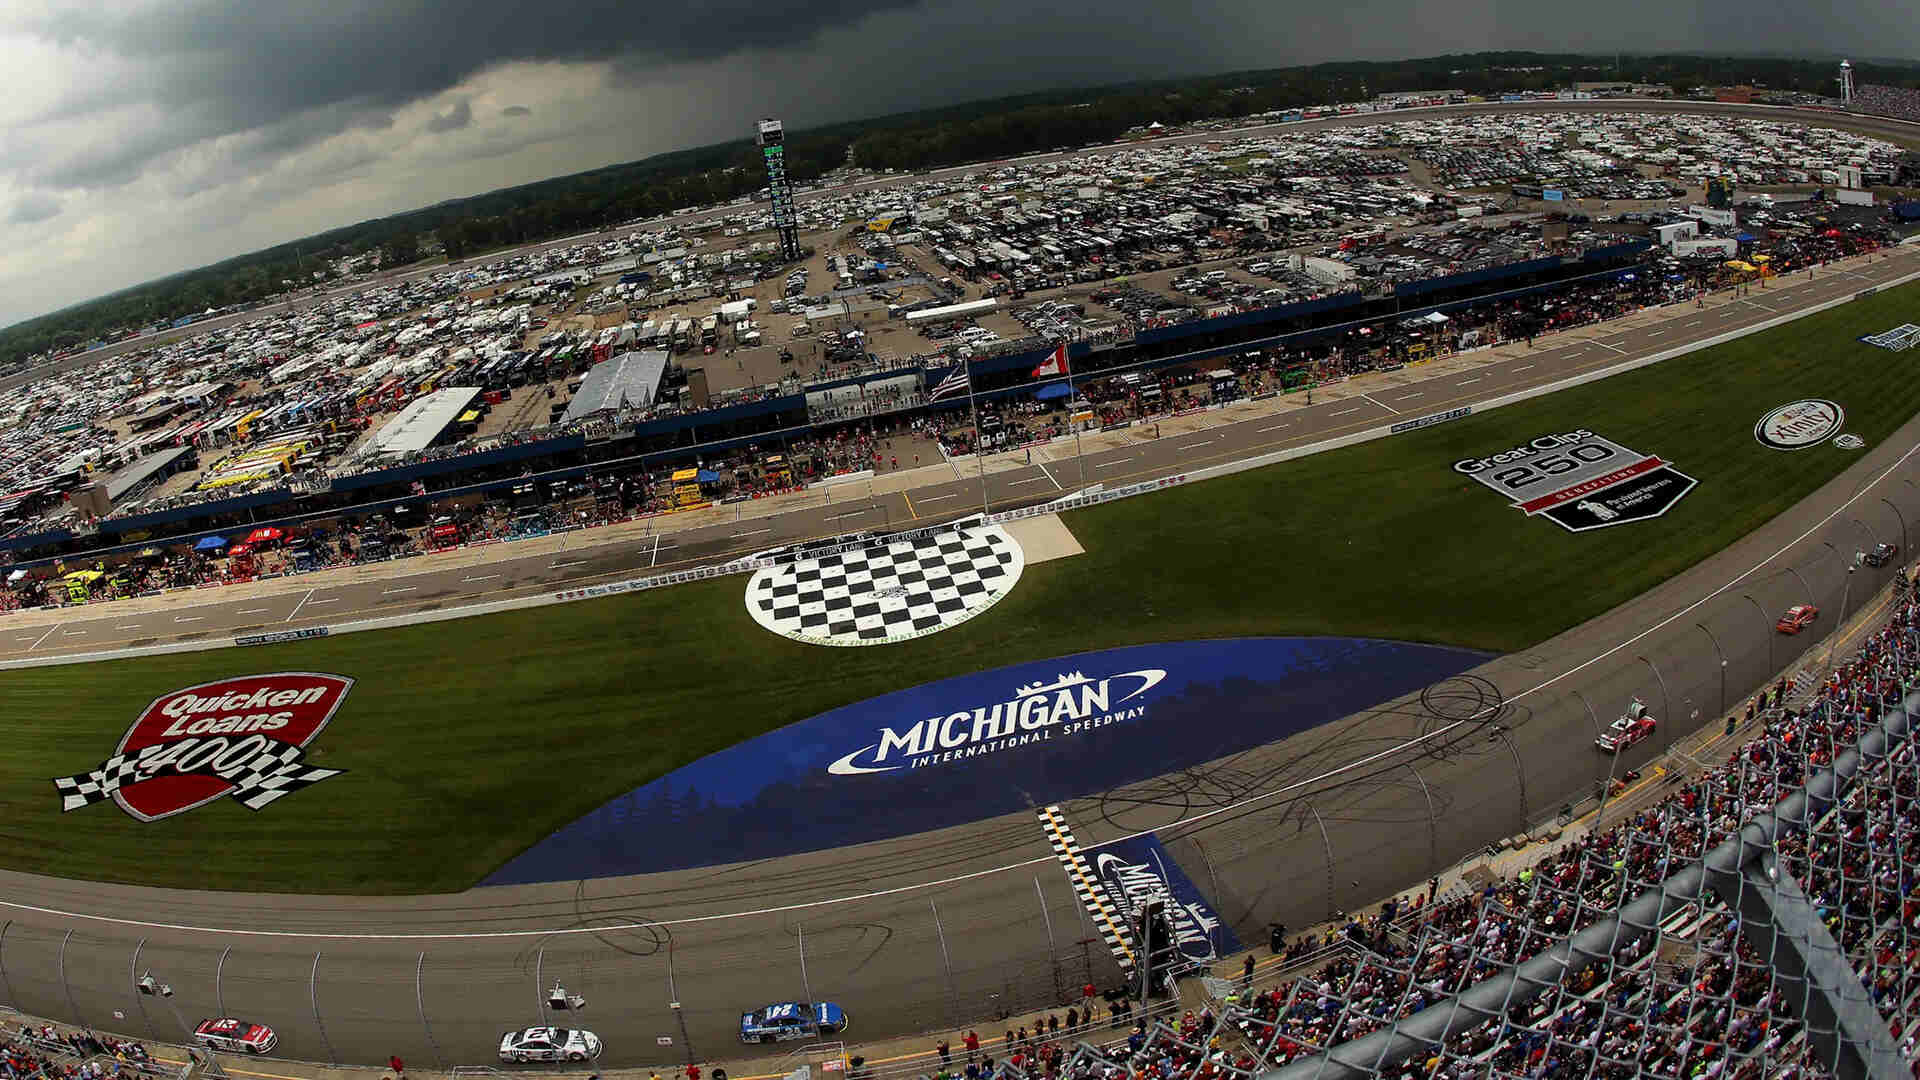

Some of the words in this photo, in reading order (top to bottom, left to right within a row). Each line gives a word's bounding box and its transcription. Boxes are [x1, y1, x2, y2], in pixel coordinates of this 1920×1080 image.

[1453, 446, 1537, 475] Great
[1530, 428, 1593, 453] Clips
[1491, 443, 1617, 490] 250
[161, 685, 328, 717] Quicken
[872, 678, 1110, 763] MICHIGAN
[161, 710, 294, 737] Loans
[911, 729, 1052, 769] INTERNATIONAL
[1063, 706, 1146, 736] SPEEDWAY
[137, 734, 268, 775] 400
[771, 1003, 793, 1019] 24
